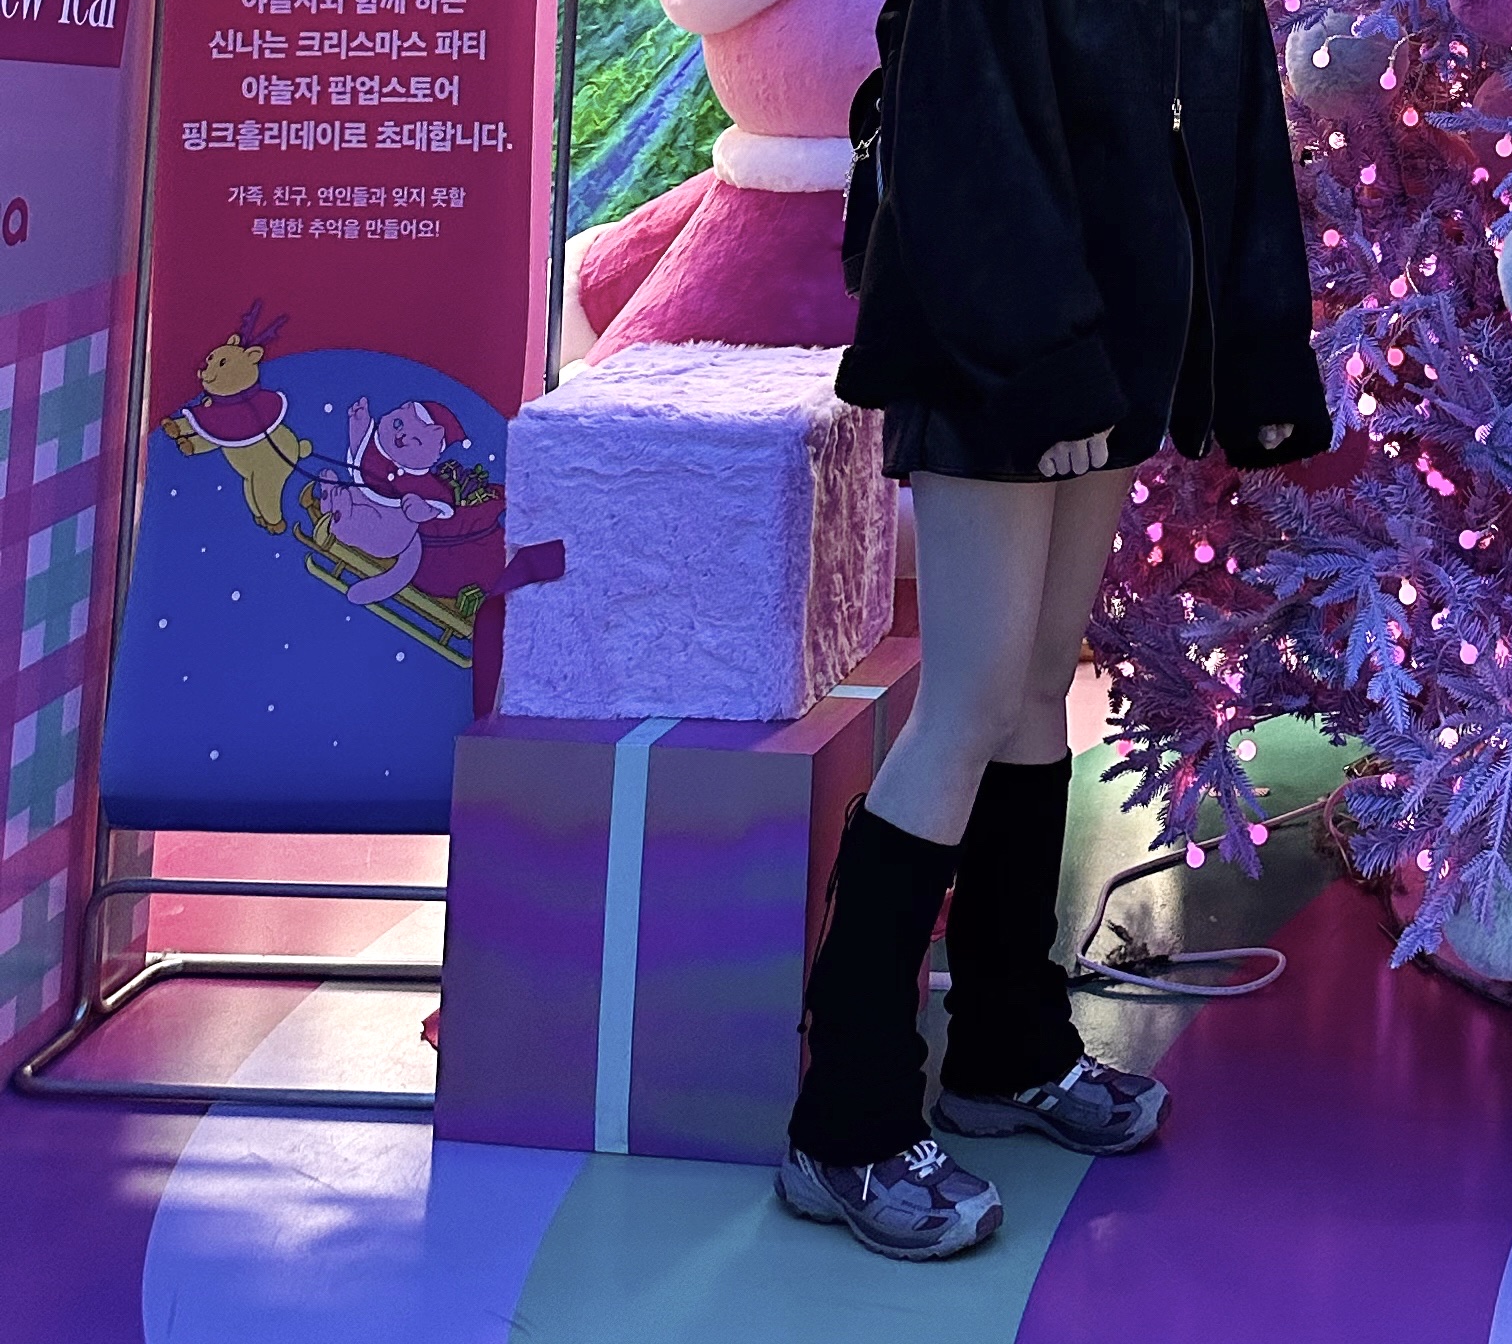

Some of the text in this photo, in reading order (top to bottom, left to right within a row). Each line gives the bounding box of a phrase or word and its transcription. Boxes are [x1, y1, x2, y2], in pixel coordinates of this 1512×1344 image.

[208, 29, 487, 60] 신나는 크리스마스 파티
[241, 74, 460, 106] 야놀자 팝업스토어
[182, 120, 513, 153] 핑크홀리데이로 초대합니다.
[227, 185, 467, 208] 가족, 친구, 연인들과 잊지 못할
[251, 217, 440, 240] 특별한 추억을 만들어요!
